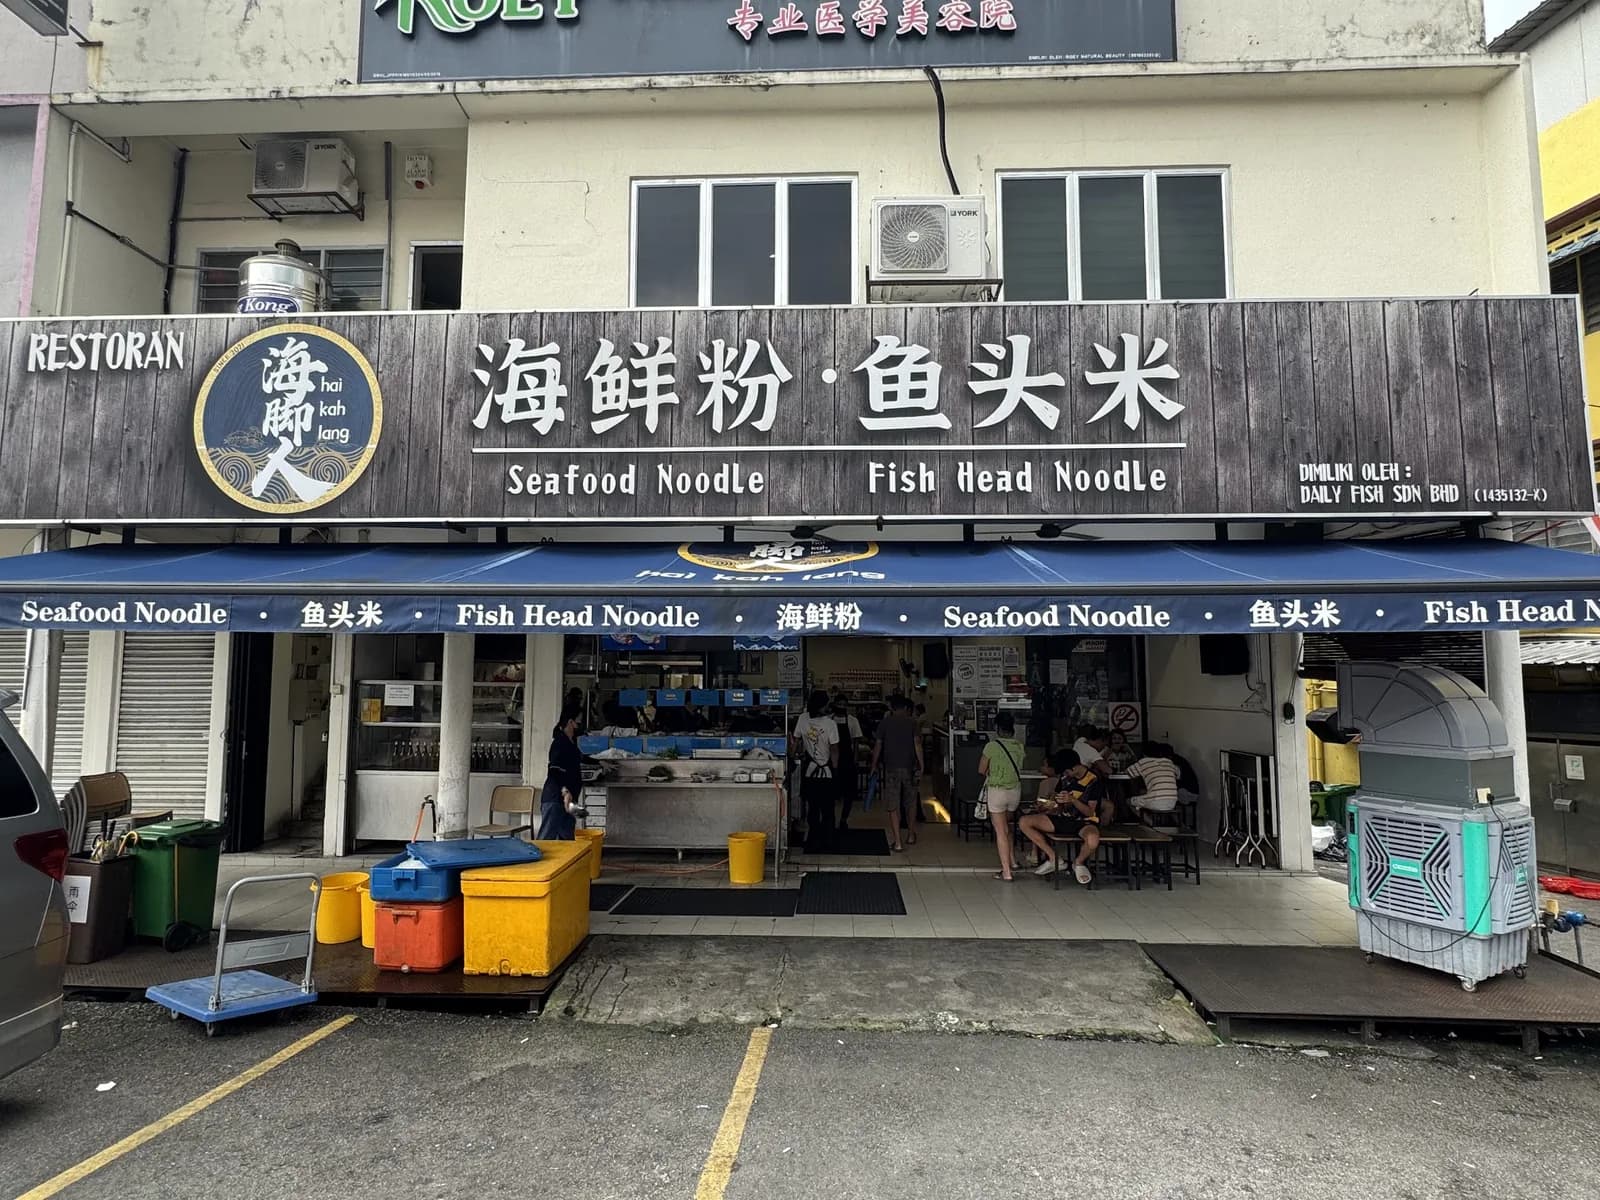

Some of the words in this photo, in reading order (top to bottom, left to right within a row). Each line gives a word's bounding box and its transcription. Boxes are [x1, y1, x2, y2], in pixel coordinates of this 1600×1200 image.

[727, 0, 1017, 40] 专业医学美容院
[244, 297, 293, 314] Kong
[27, 331, 185, 372] RESTORAN
[320, 376, 344, 392] hai
[319, 400, 347, 417] kah
[318, 425, 350, 444] lang
[507, 463, 636, 495] Seafood
[868, 460, 936, 493] Fish
[956, 460, 1033, 493] Head
[1299, 463, 1354, 482] DIMILIKI
[1300, 486, 1342, 504] DAILY
[1351, 485, 1385, 504] FISH
[1393, 485, 1423, 504] SDN
[1430, 485, 1460, 504] BHD
[635, 570, 697, 580] hai
[712, 573, 784, 582] kah
[801, 570, 886, 581] lang
[20, 601, 127, 623] Seafood
[134, 601, 227, 624] Noodle
[300, 600, 384, 629] 鱼头米
[456, 604, 515, 627] Fish
[524, 604, 594, 627] Head
[602, 605, 700, 628] Noodle
[776, 602, 863, 631] 海鲜粉
[944, 605, 1060, 629] Seafood
[1067, 604, 1171, 628] Noodle
[1249, 599, 1342, 629] 鱼头米
[1424, 600, 1489, 624] Fish
[1497, 599, 1576, 623] Head
